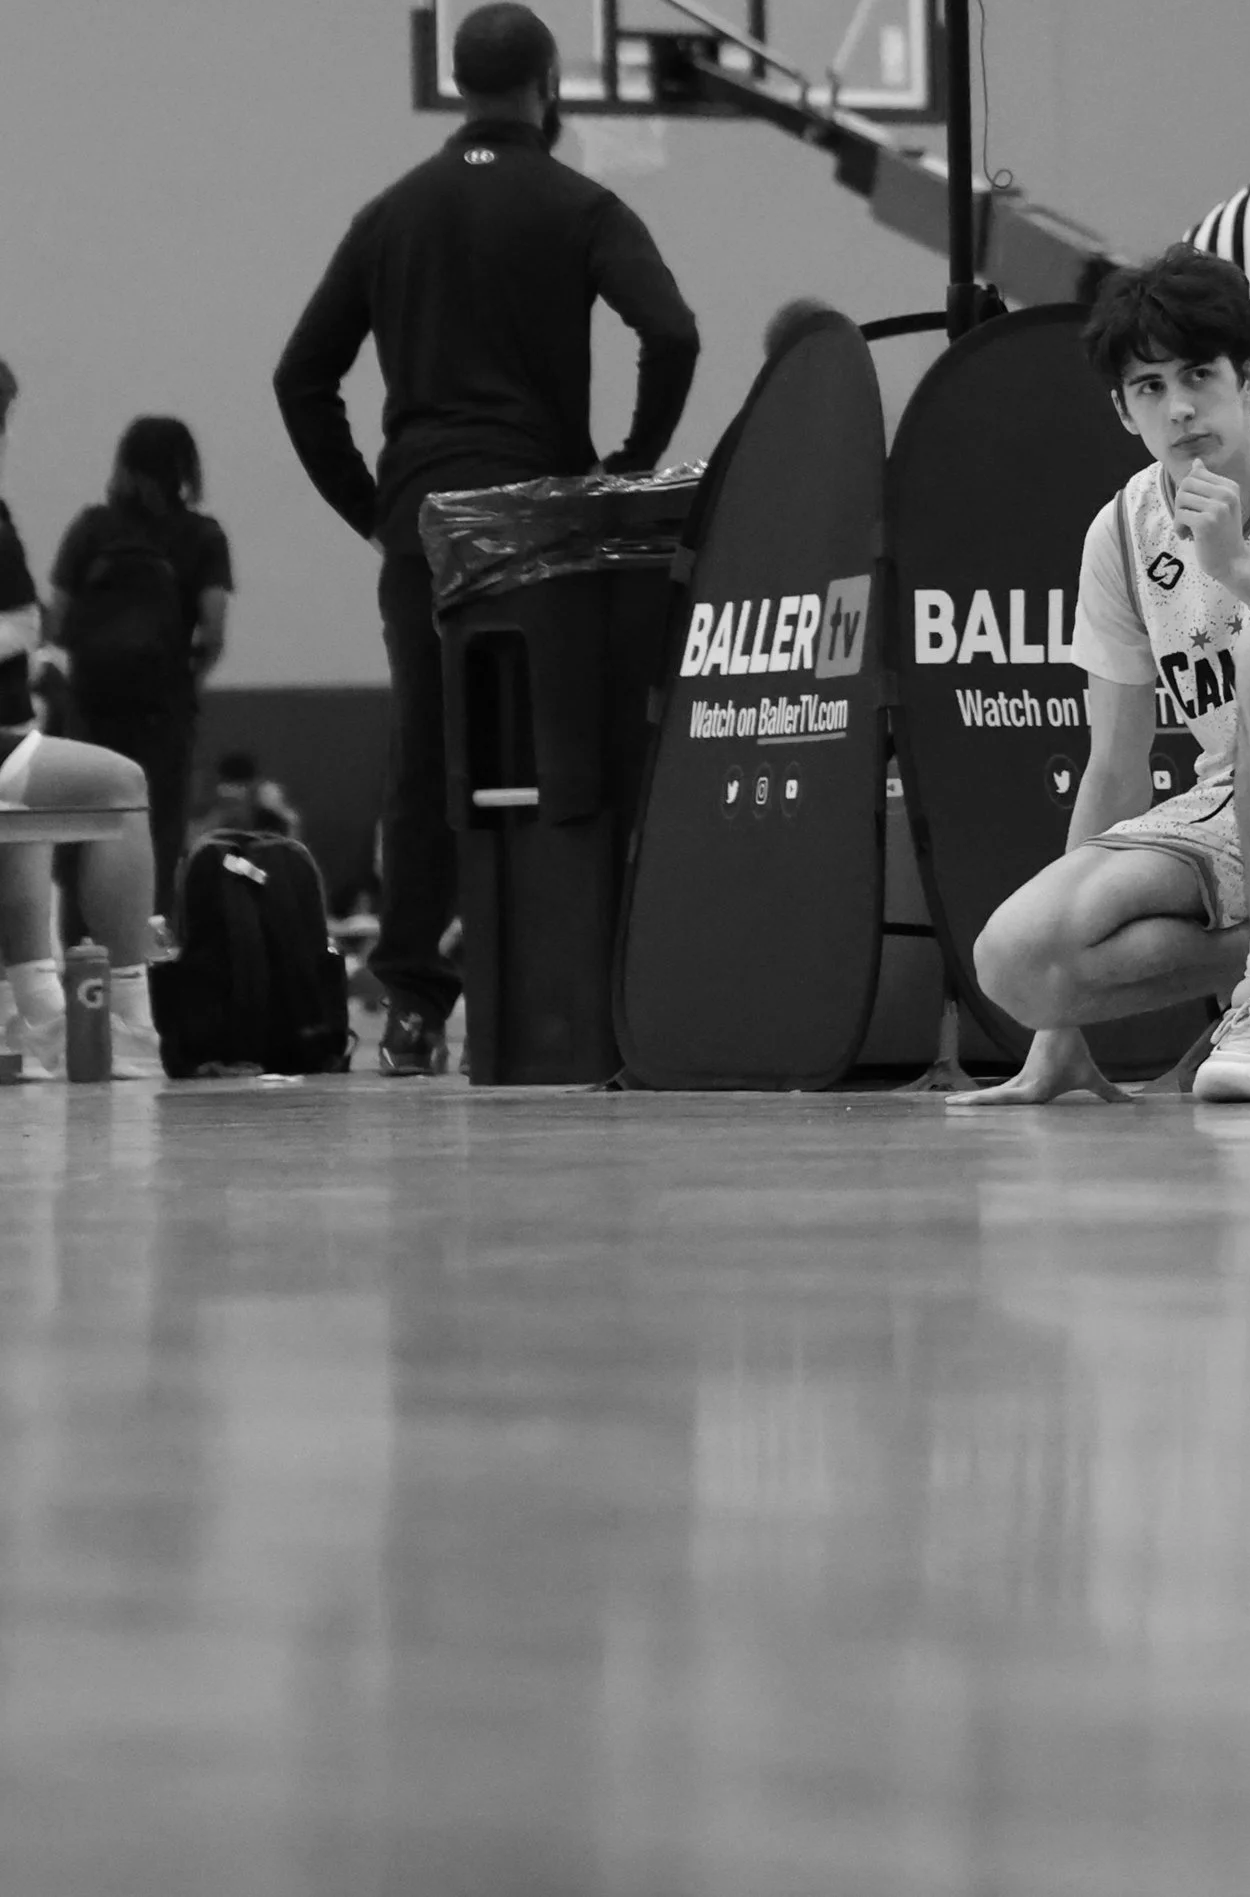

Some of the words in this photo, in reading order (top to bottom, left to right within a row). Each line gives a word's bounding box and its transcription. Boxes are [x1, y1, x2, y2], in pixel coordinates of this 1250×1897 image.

[679, 594, 821, 677] BALLER
[827, 596, 861, 661] tv
[914, 589, 1073, 664] BALL
[690, 700, 737, 738] Watch
[737, 706, 757, 737] on
[757, 694, 848, 736] BallerTV.com
[955, 689, 1042, 727] Watch
[1046, 697, 1079, 727] on
